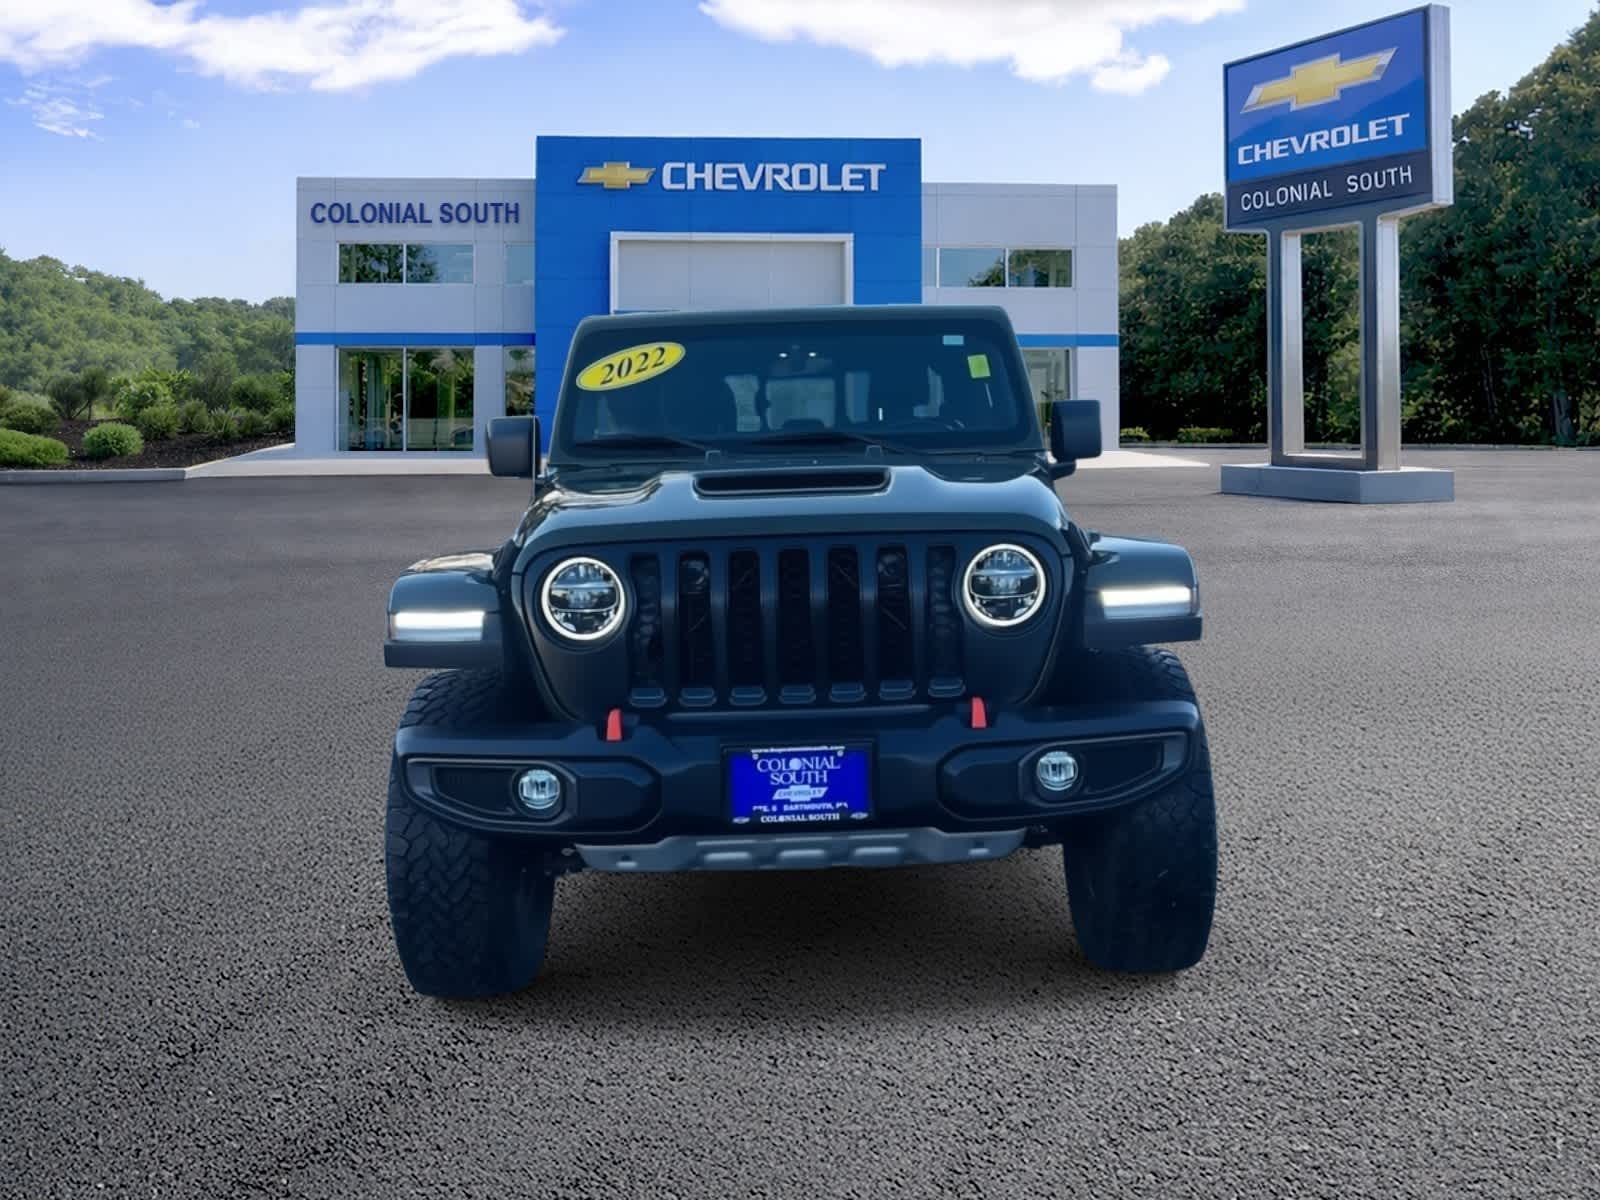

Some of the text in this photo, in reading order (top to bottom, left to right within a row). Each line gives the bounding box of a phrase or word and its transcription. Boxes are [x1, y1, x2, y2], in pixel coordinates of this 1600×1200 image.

[1238, 113, 1410, 165] CHEVROLET
[661, 162, 887, 192] CHEVROLET
[1240, 165, 1412, 211] COLONIAL SOUTH
[310, 202, 520, 224] COLONIAL SOUTH
[600, 346, 665, 385] 2022
[756, 756, 841, 773] COLONIAL
[770, 770, 828, 786] SOUTH
[760, 812, 840, 824] COLONIAL SOUTH
